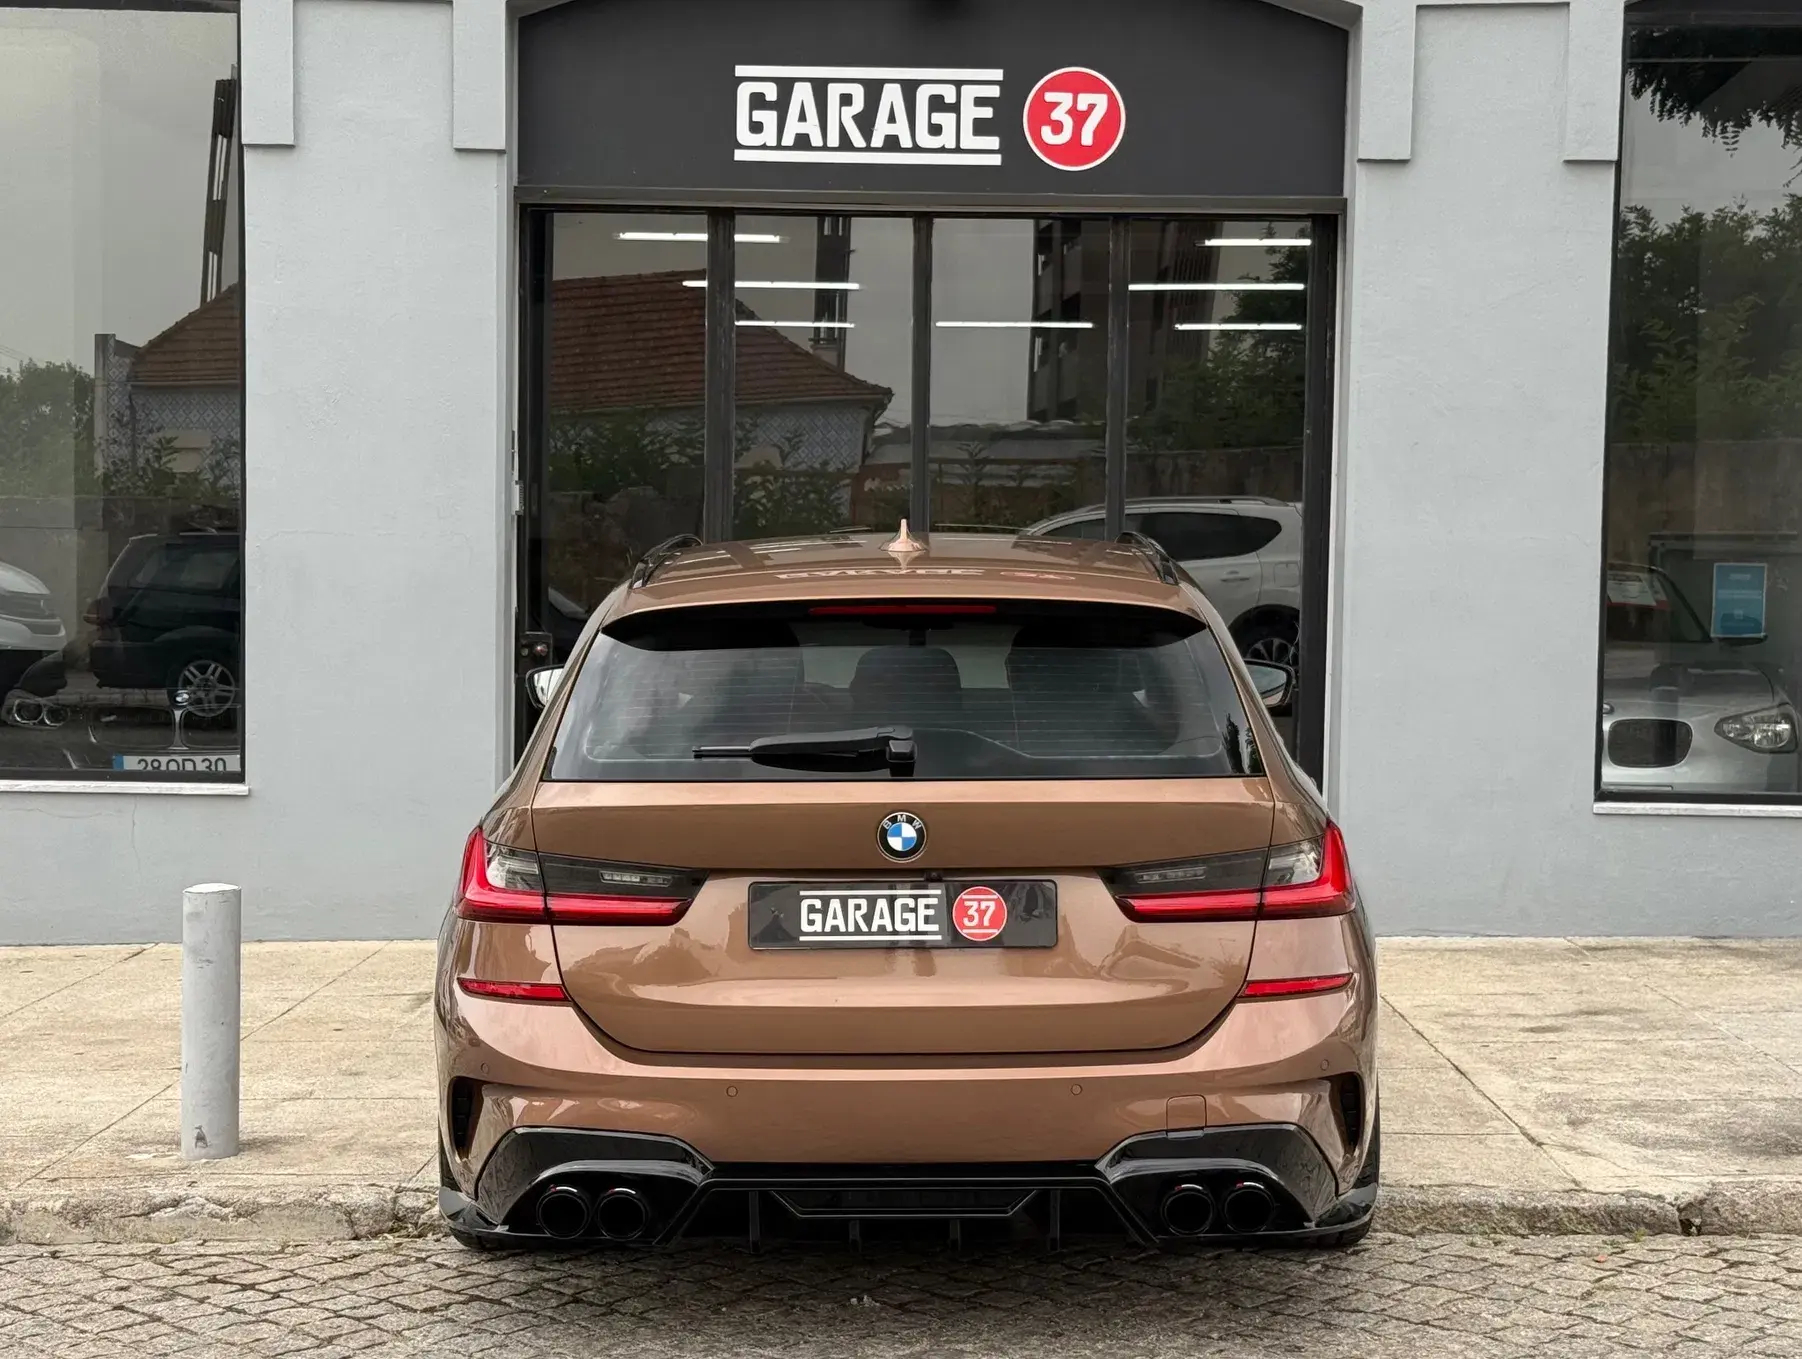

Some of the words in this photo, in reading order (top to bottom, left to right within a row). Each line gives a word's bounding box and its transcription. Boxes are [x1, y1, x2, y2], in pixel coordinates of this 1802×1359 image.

[736, 81, 1000, 150] GARAGE
[1040, 91, 1108, 147] 37
[882, 814, 923, 830] BMW
[800, 898, 939, 932] GARAGE
[962, 900, 996, 927] 37
